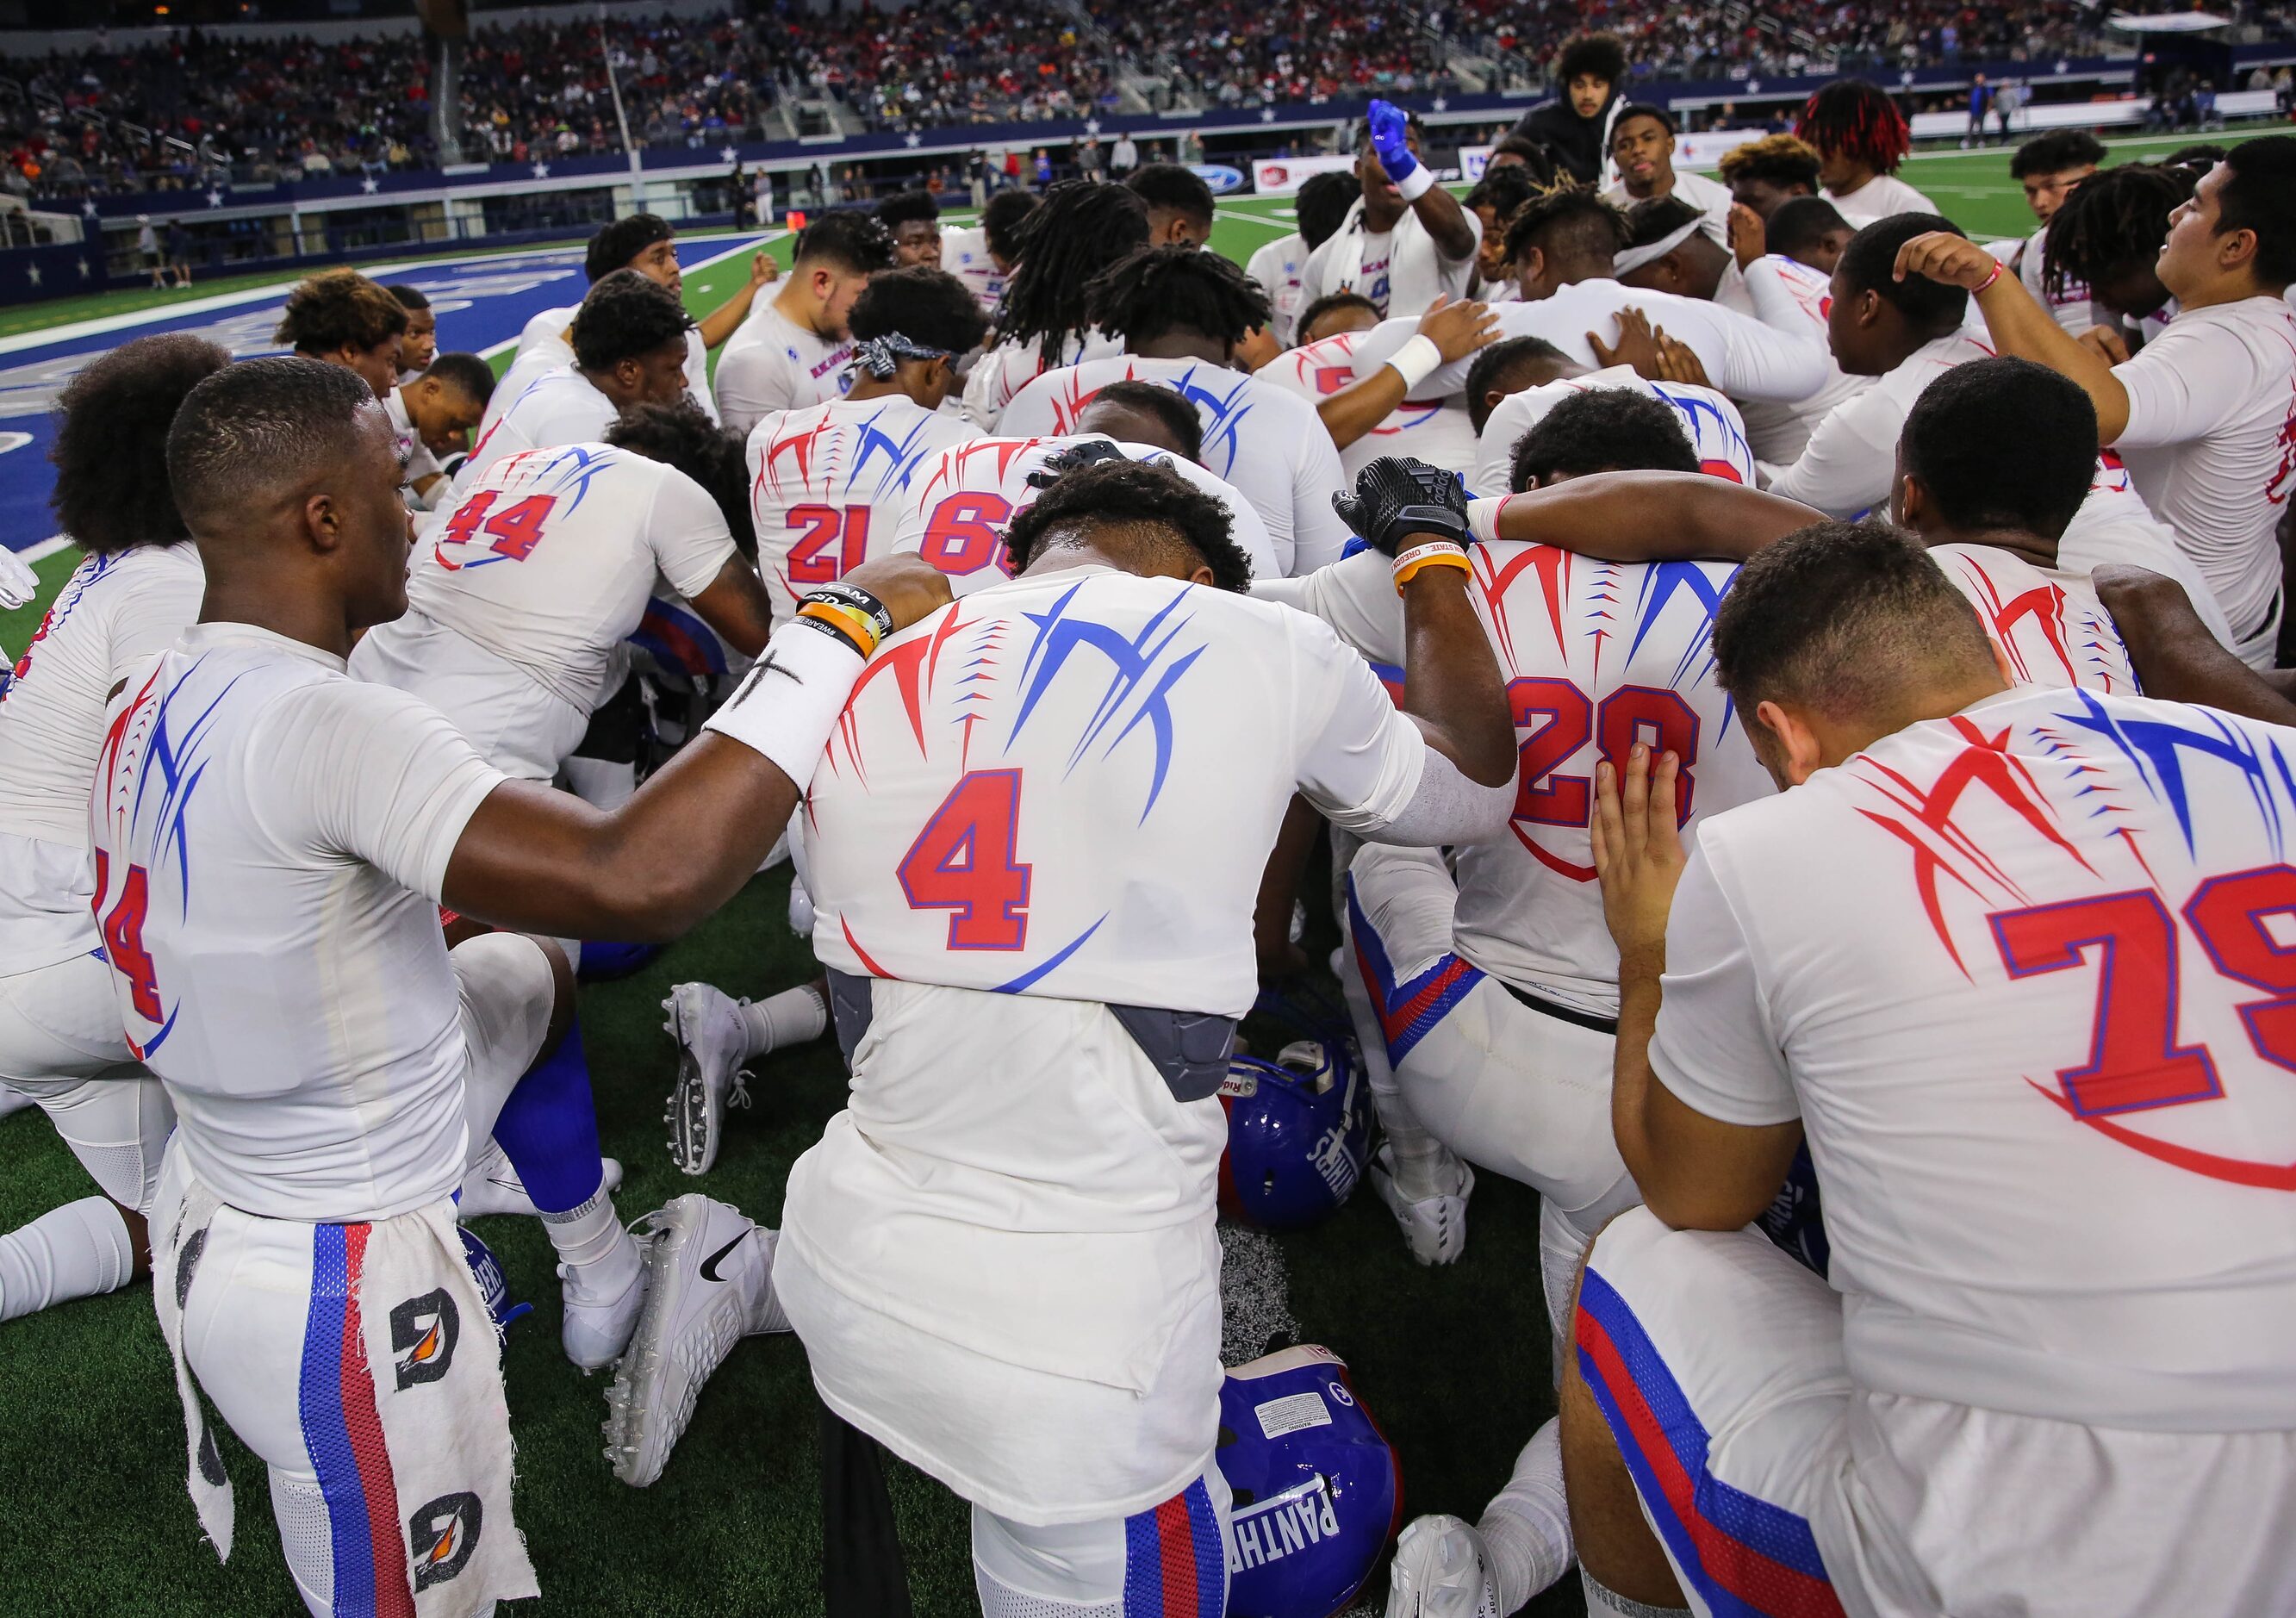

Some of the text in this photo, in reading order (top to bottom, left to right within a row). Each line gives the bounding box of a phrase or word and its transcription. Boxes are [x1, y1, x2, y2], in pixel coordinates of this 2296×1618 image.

[1434, 469, 1453, 505] adida
[443, 489, 558, 563] 44
[785, 503, 871, 584] 21
[918, 491, 1035, 580] 6
[1393, 549, 1422, 569] OREGON
[1504, 675, 1701, 830] 28
[896, 768, 1033, 952] 4
[1986, 862, 2296, 1120] 79
[1288, 1421, 1313, 1432] WARNING
[1485, 1580, 1496, 1615] VAPOR
